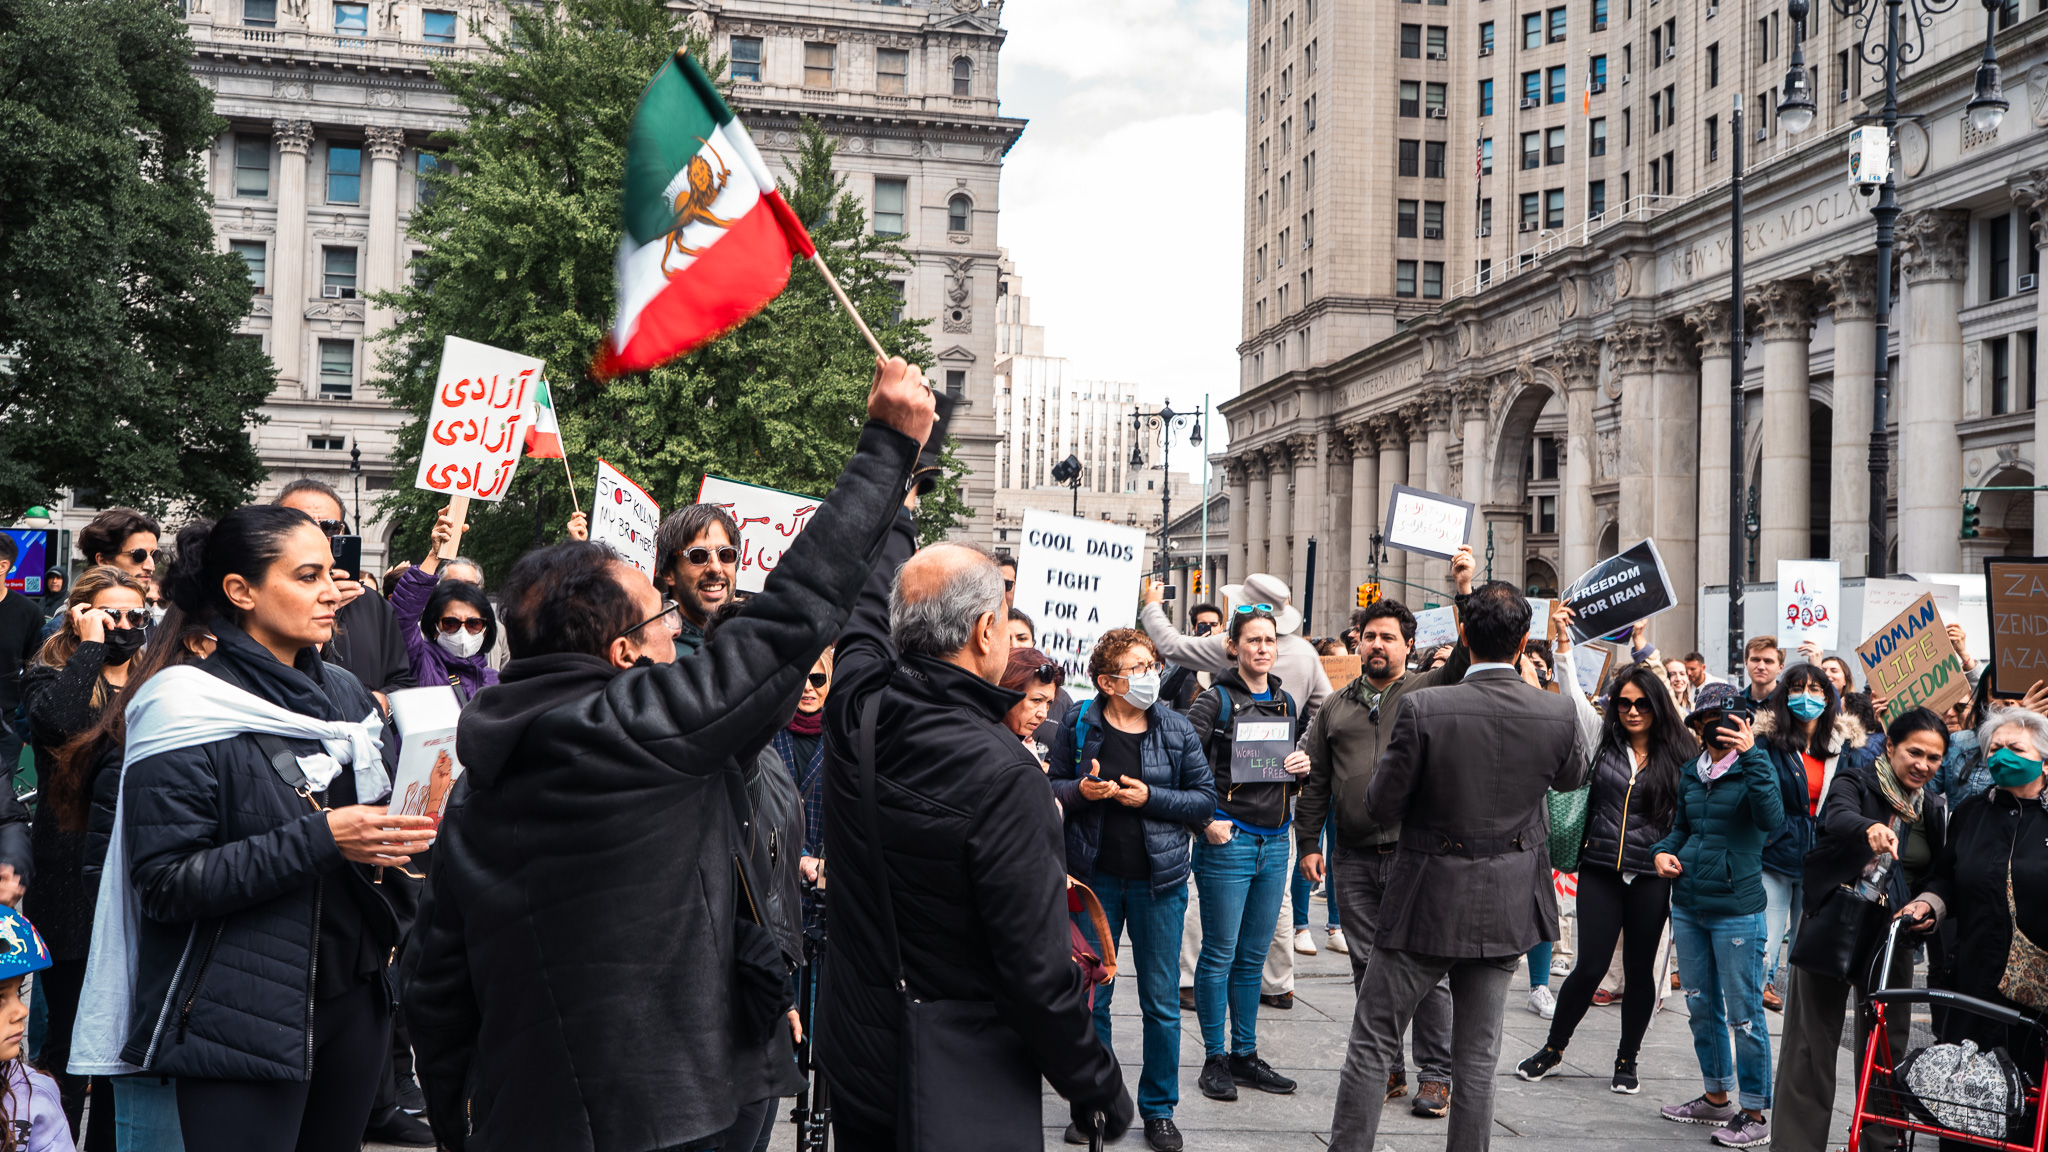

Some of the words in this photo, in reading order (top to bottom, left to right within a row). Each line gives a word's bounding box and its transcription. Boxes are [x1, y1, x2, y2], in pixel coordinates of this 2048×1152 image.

[1671, 245, 1707, 281] NEW
[441, 368, 536, 409] آزادی
[1350, 370, 1396, 402] AMSTERDAM
[432, 414, 521, 453] آزادی
[426, 459, 515, 497] آزادی
[599, 476, 632, 507] STOP
[600, 506, 616, 532] MY
[1029, 529, 1075, 552] COOL
[1086, 539, 1133, 562] DADS
[1047, 569, 1101, 592] FIGHT
[1573, 565, 1641, 602] FREEDOM
[1044, 600, 1078, 621] FOR
[1087, 606, 1099, 624] A
[1579, 598, 1608, 619] FOR
[1610, 582, 1647, 606] IRAN
[1042, 632, 1088, 656] FREE
[1860, 600, 1935, 669] WOMAN
[900, 666, 929, 682] NAUTICA
[1878, 632, 1938, 694] LIFE
[1251, 757, 1278, 768] LIFE
[1262, 767, 1289, 778] FREED
